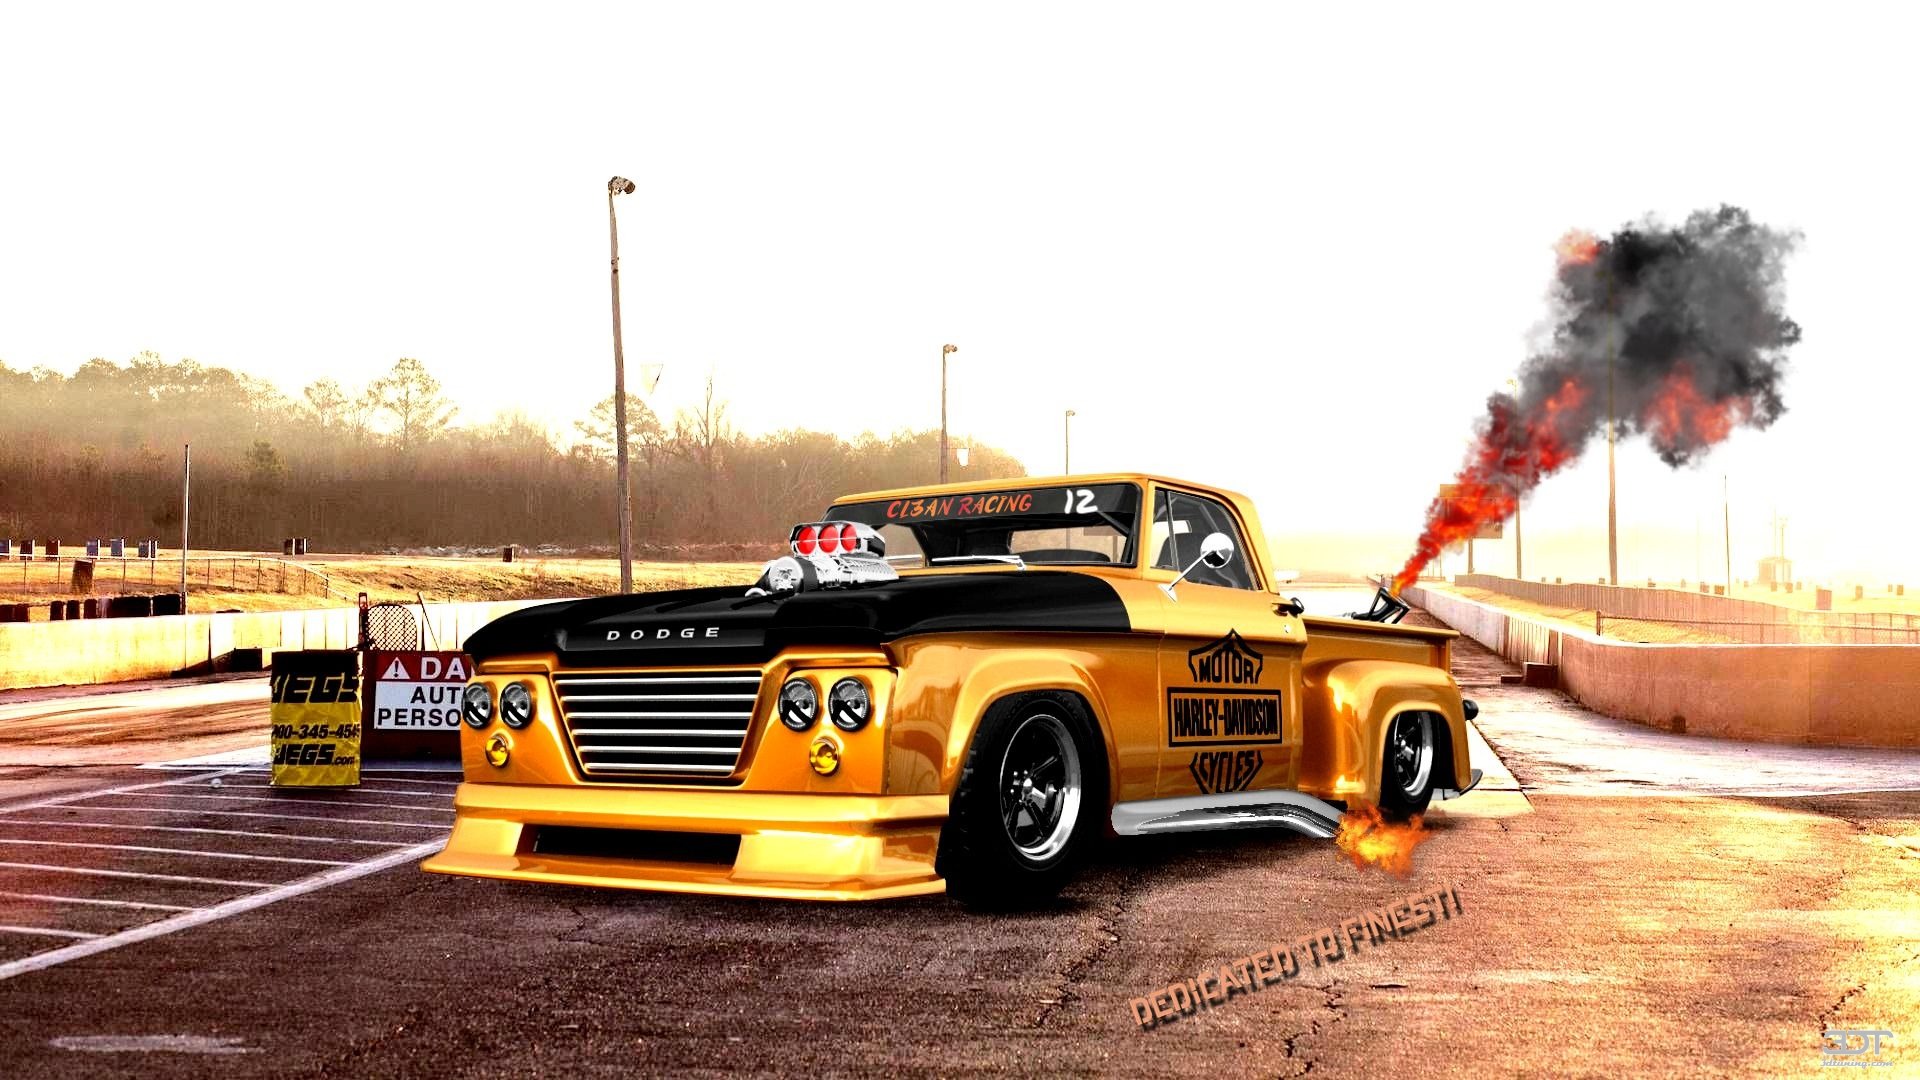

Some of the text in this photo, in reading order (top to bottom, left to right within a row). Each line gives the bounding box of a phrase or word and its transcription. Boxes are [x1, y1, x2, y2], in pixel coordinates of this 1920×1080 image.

[957, 494, 1033, 515] RACING
[1064, 489, 1098, 514] 12
[607, 627, 720, 641] DODGE
[421, 656, 474, 680] DA
[1199, 643, 1254, 684] MOTOR
[410, 686, 466, 704] AUT
[1173, 698, 1279, 737] HARLEY-DAVIDSON
[1199, 750, 1256, 793] CYCLES
